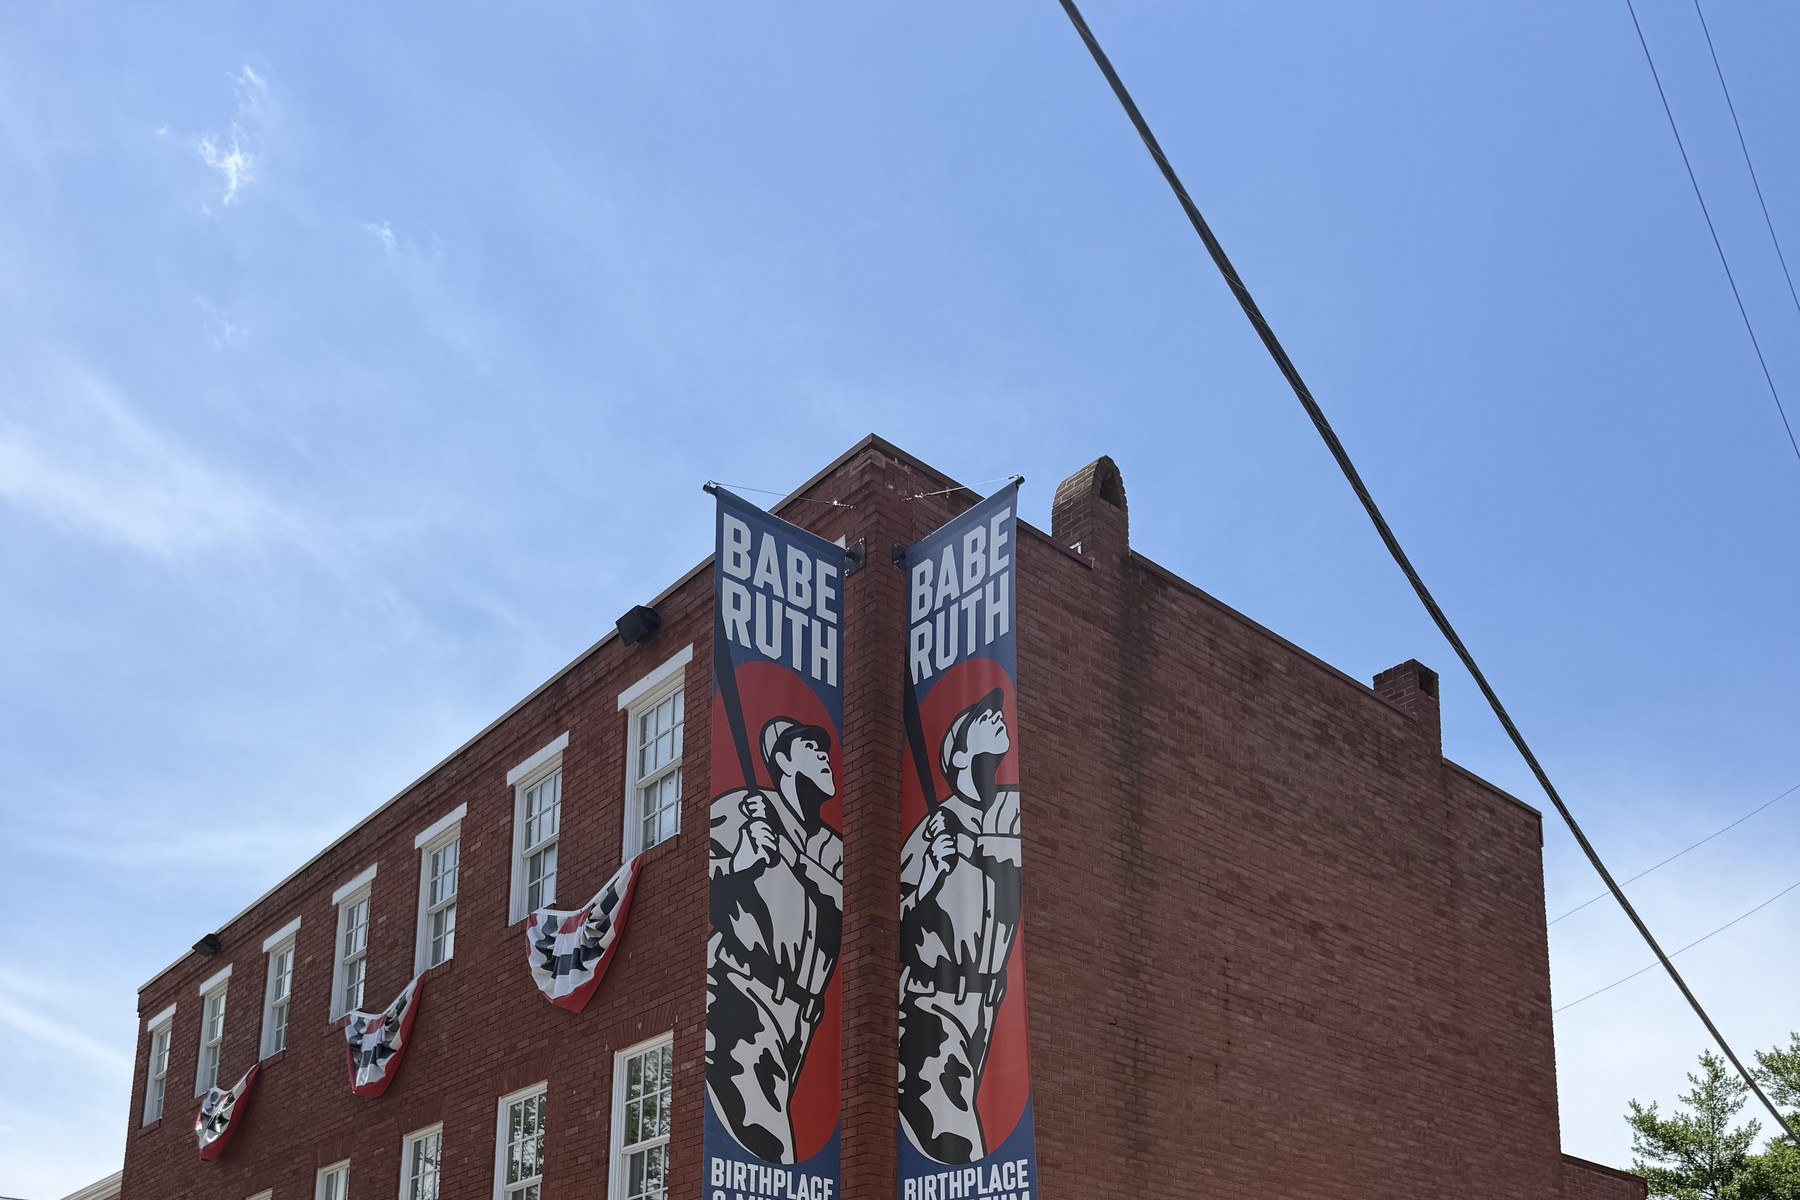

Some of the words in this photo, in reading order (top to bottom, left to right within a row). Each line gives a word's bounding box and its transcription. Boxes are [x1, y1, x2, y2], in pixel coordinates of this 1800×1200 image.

[723, 512, 838, 625] BABE
[910, 506, 1011, 625] BABE
[721, 576, 838, 688] RUTH
[909, 570, 1009, 687] RUTH
